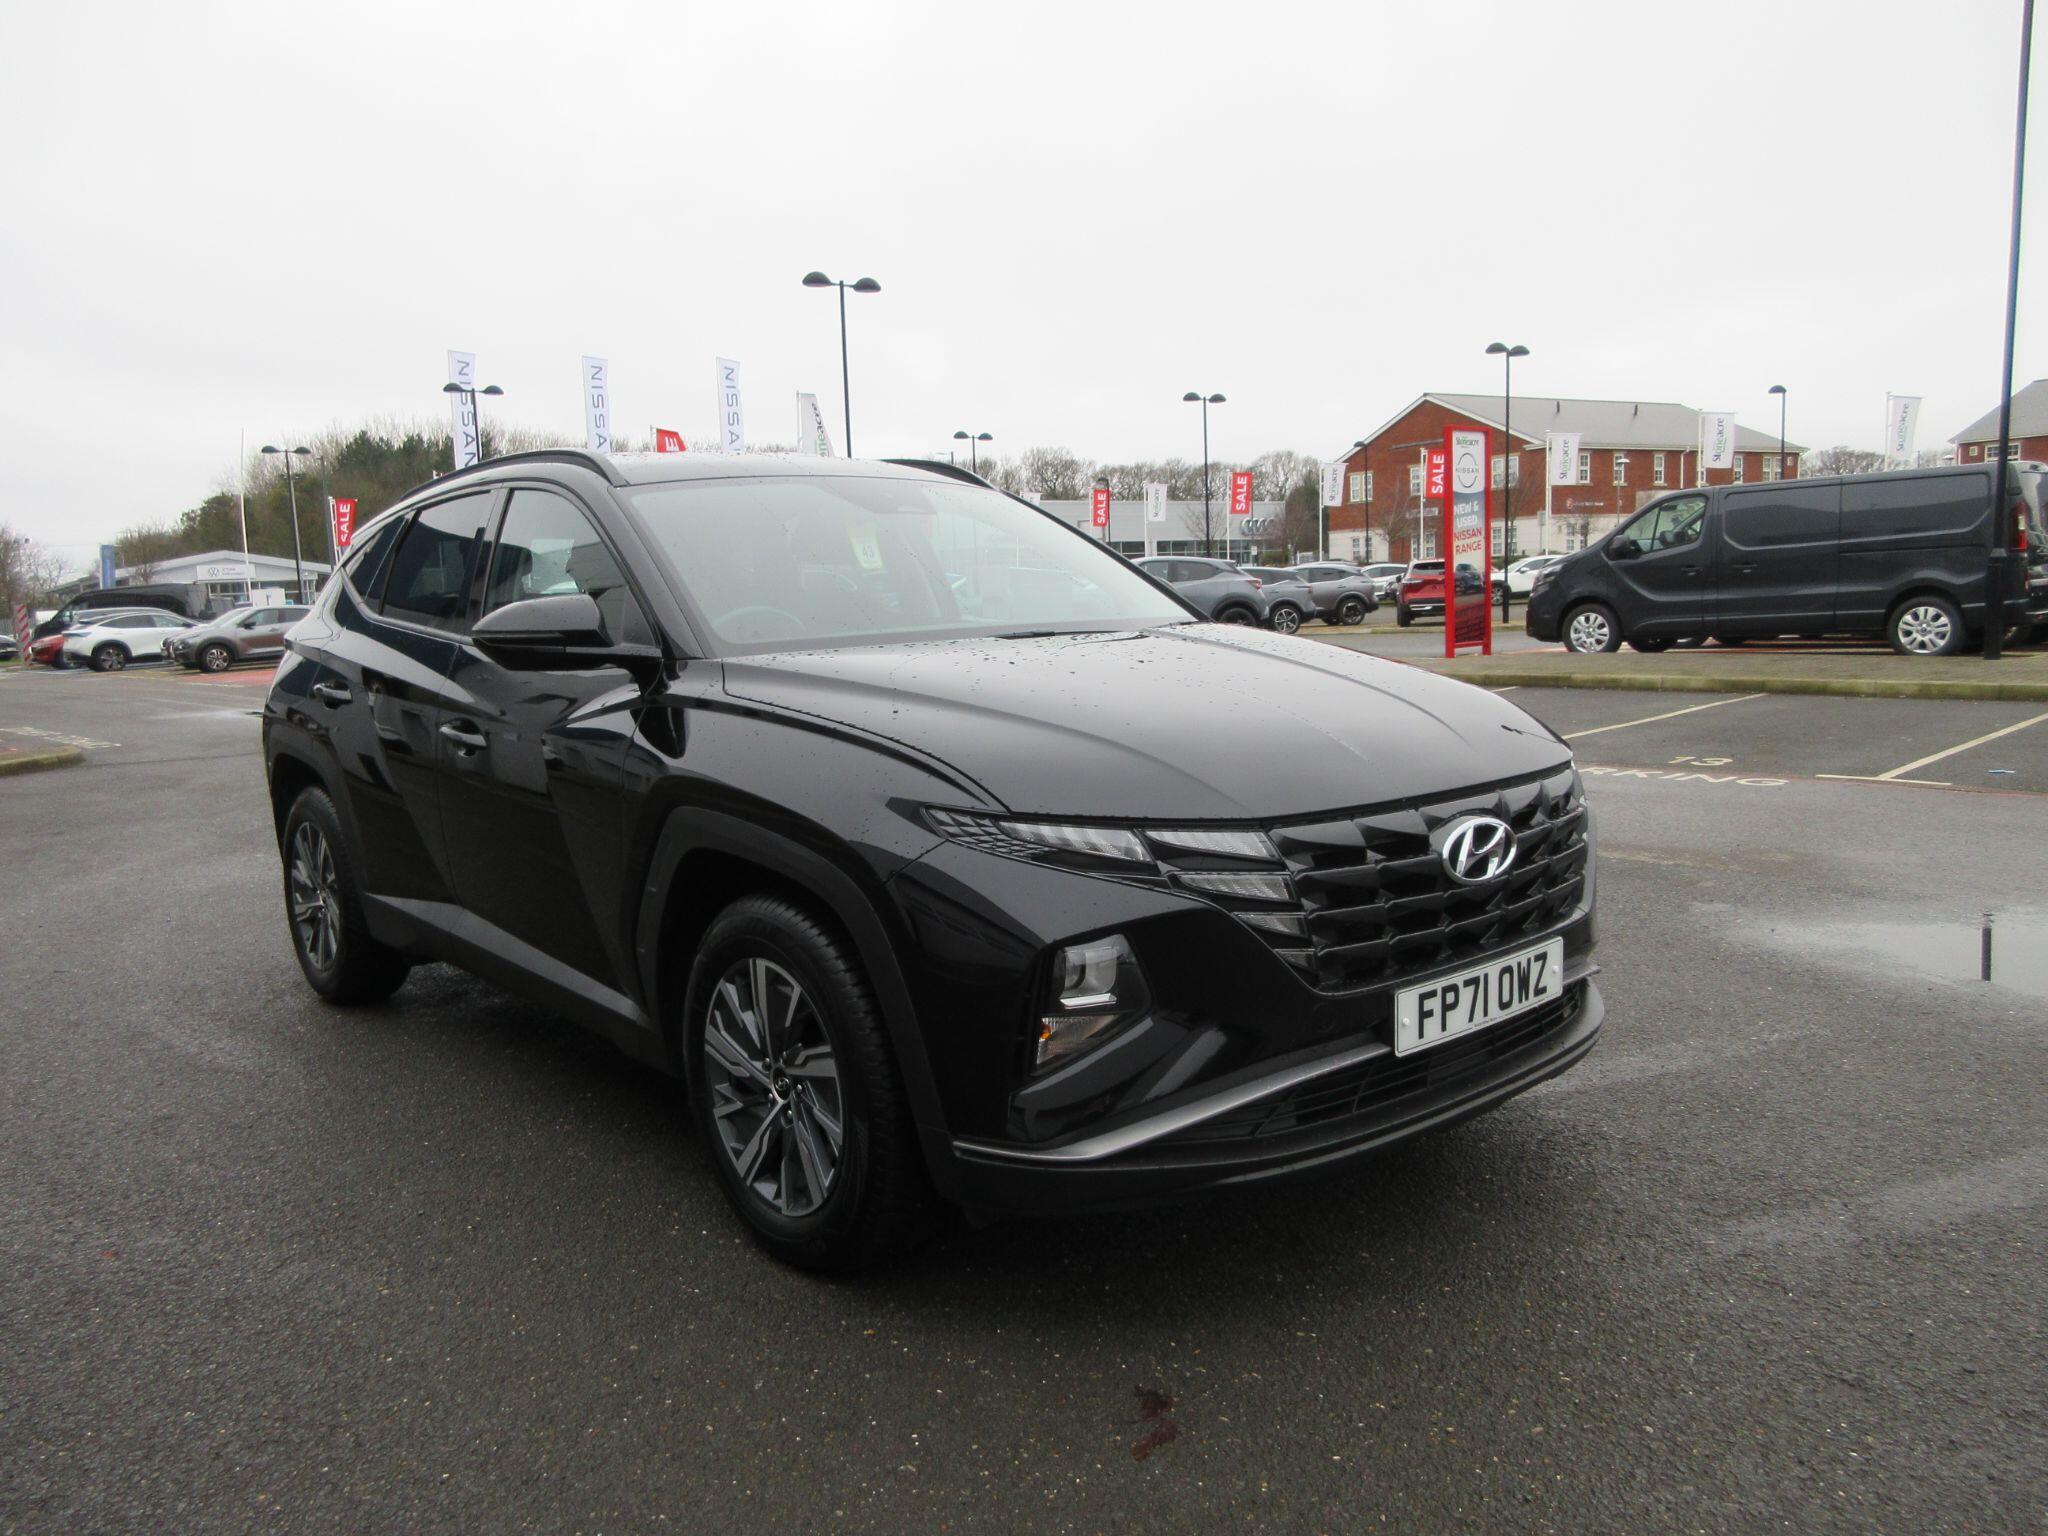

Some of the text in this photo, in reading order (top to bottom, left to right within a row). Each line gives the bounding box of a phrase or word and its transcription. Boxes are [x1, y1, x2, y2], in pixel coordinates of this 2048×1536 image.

[591, 365, 607, 448] NISSA
[724, 366, 740, 454] NISSA
[1431, 454, 1445, 494] SALE
[1097, 492, 1107, 523] SALE
[1236, 475, 1248, 511] SALE
[1454, 500, 1479, 515] NEW &
[340, 503, 350, 542] SALE
[1454, 527, 1482, 541] NISSAN
[1456, 515, 1478, 528] USED
[1455, 540, 1482, 554] RANGE
[1577, 767, 1790, 786] RKING
[1667, 756, 1734, 766] 13
[1418, 951, 1548, 1040] FP71 OWZ
